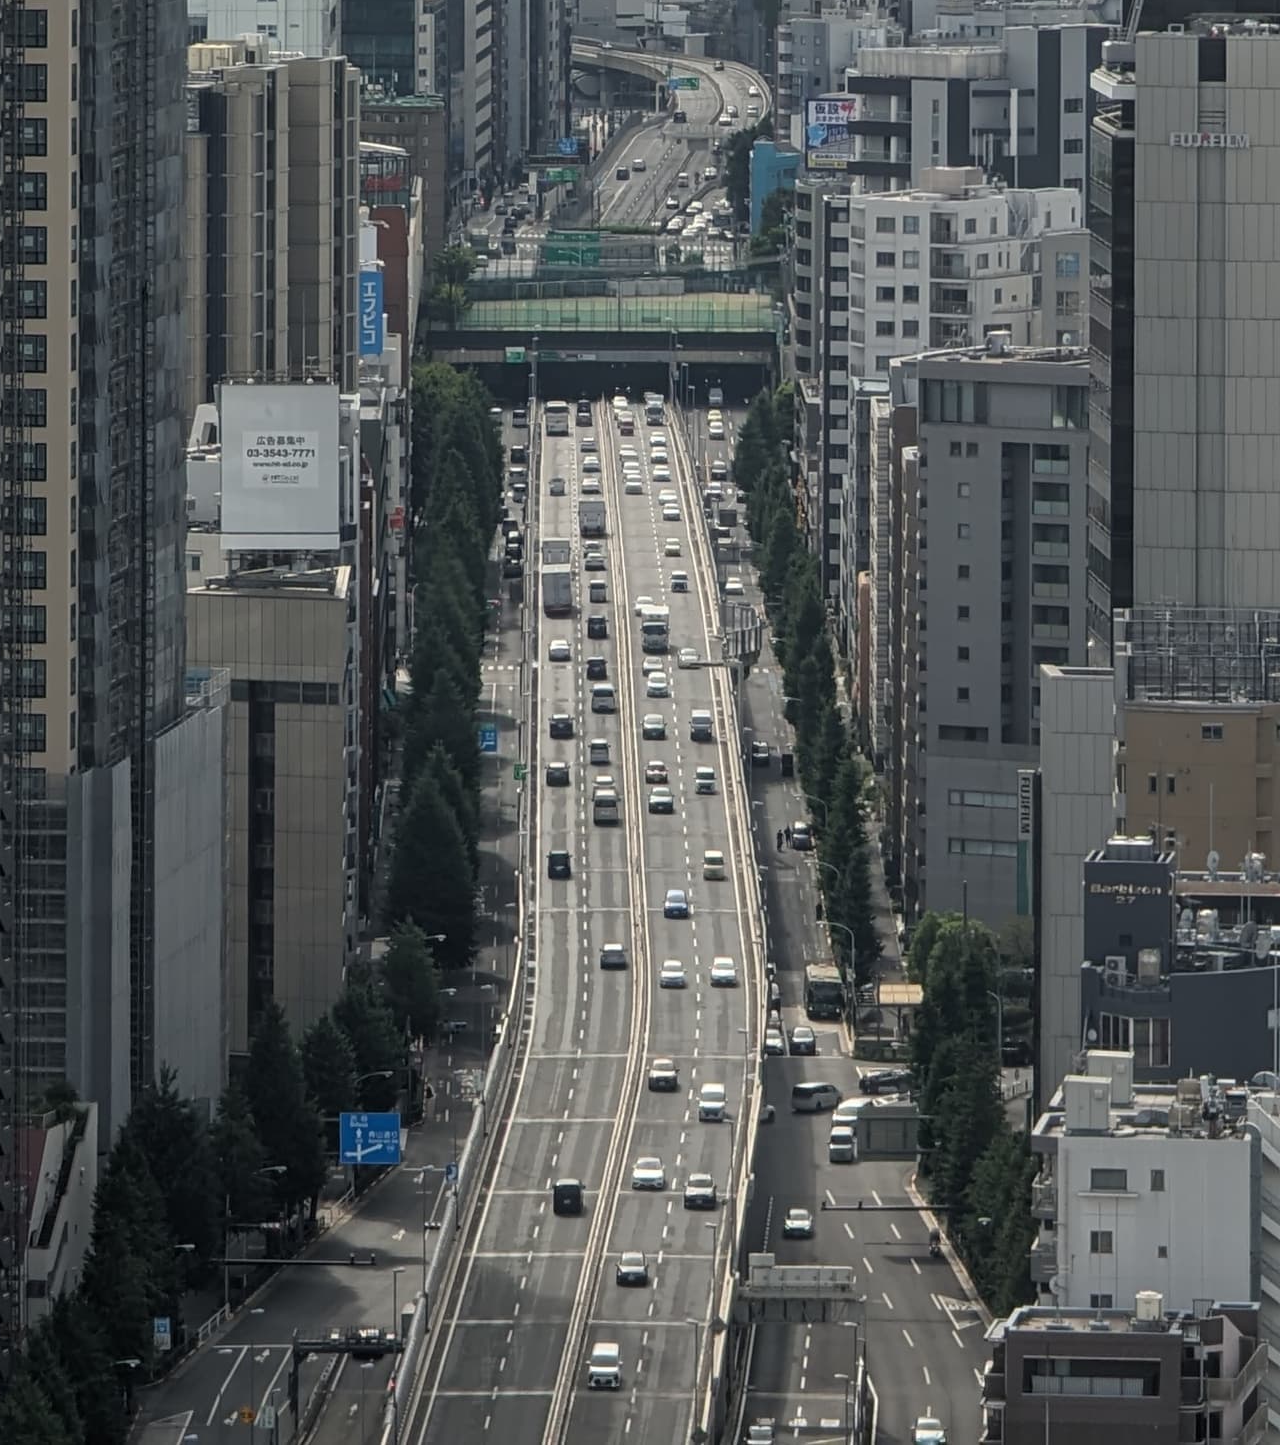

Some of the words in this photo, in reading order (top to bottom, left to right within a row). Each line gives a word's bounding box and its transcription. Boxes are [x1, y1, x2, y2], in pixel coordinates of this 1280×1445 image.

[1169, 133, 1249, 148] FUJIFILM
[363, 282, 376, 345] エフピコ
[256, 436, 305, 446] 広告募集中
[246, 449, 315, 458] 03-3543-7771
[1021, 777, 1030, 834] FUJIFILM
